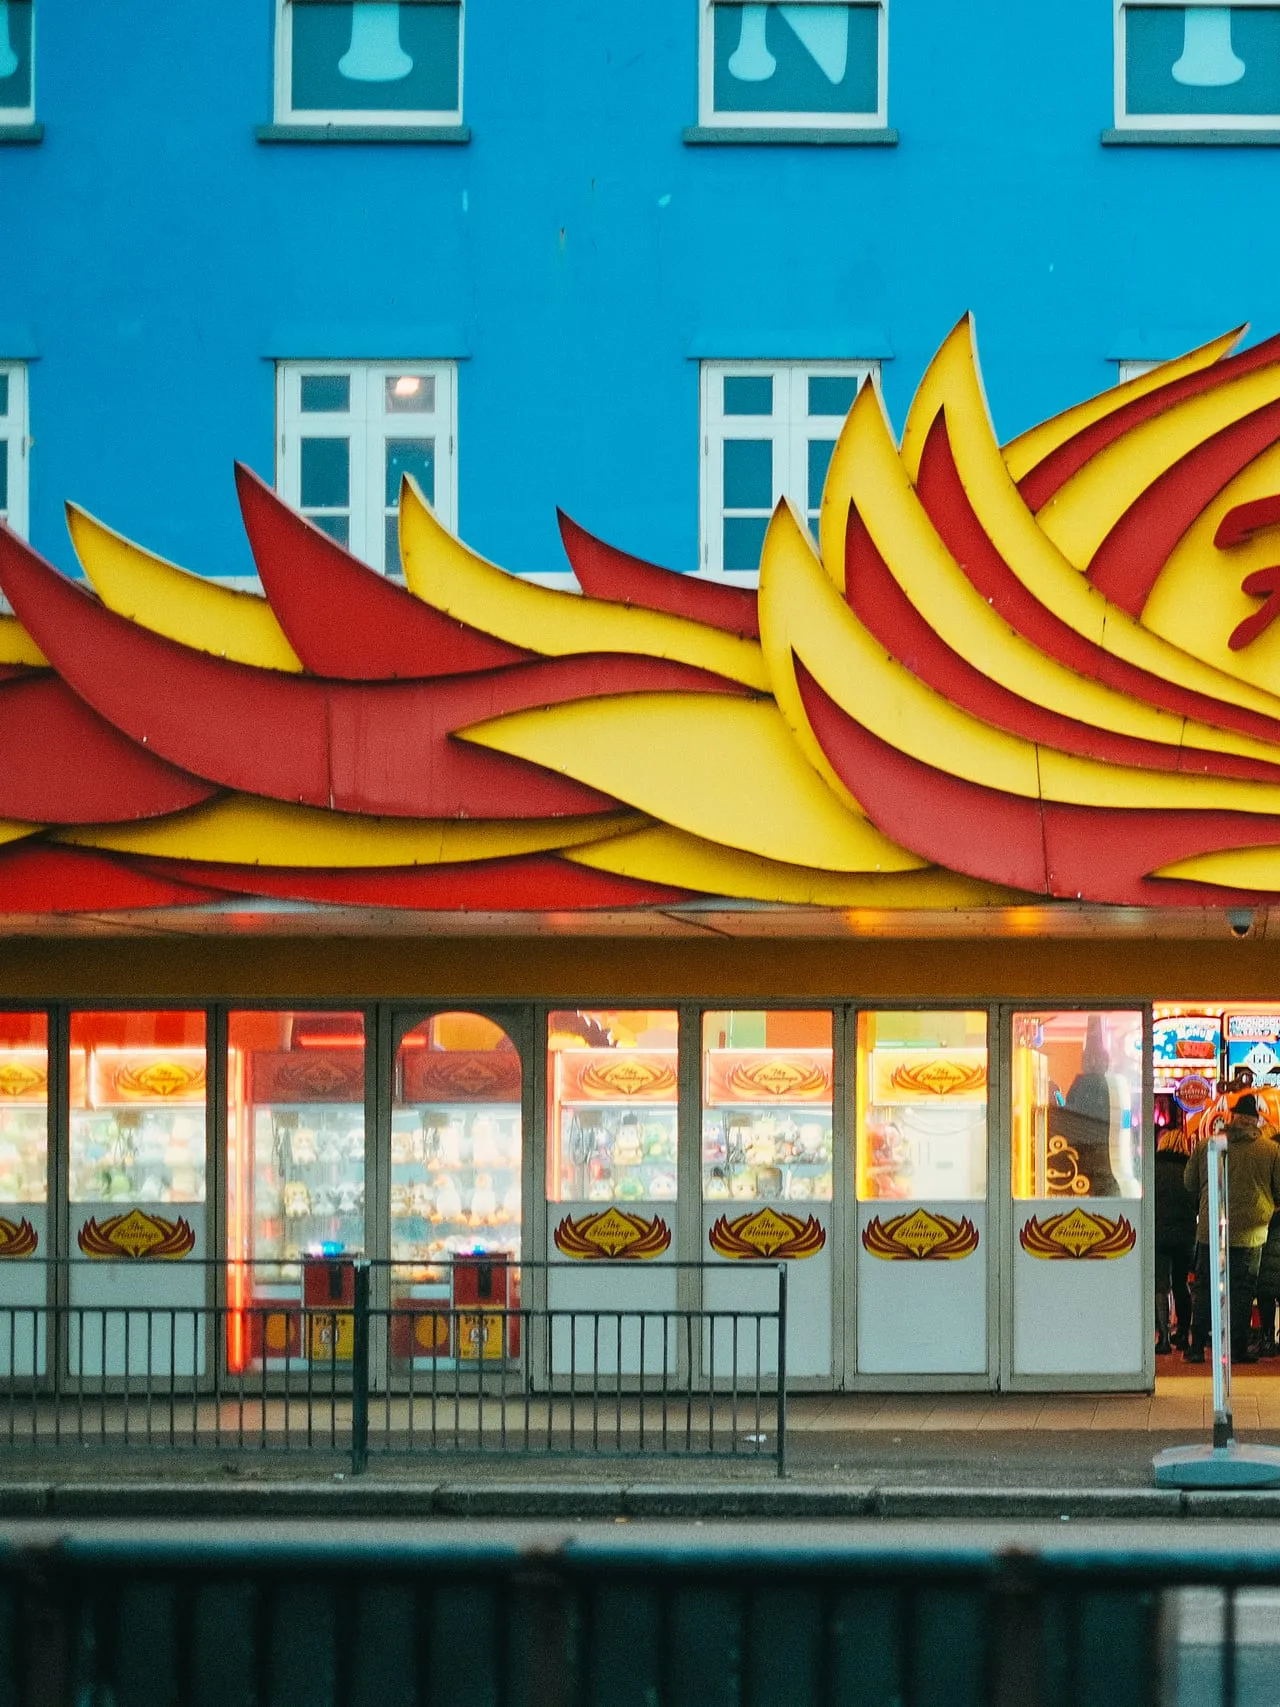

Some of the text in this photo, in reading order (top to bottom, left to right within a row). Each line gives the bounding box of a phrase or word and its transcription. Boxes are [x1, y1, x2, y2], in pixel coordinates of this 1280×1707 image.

[126, 1221, 144, 1231] The
[603, 1218, 621, 1229] The
[757, 1217, 775, 1228] The
[911, 1217, 929, 1228] The
[1068, 1219, 1087, 1229] The
[119, 1229, 159, 1240] Flamingo
[589, 1228, 634, 1239] Flamingo
[744, 1226, 790, 1239] Flamingo
[897, 1226, 943, 1239] Flamingo
[1055, 1227, 1101, 1240] Flamingo
